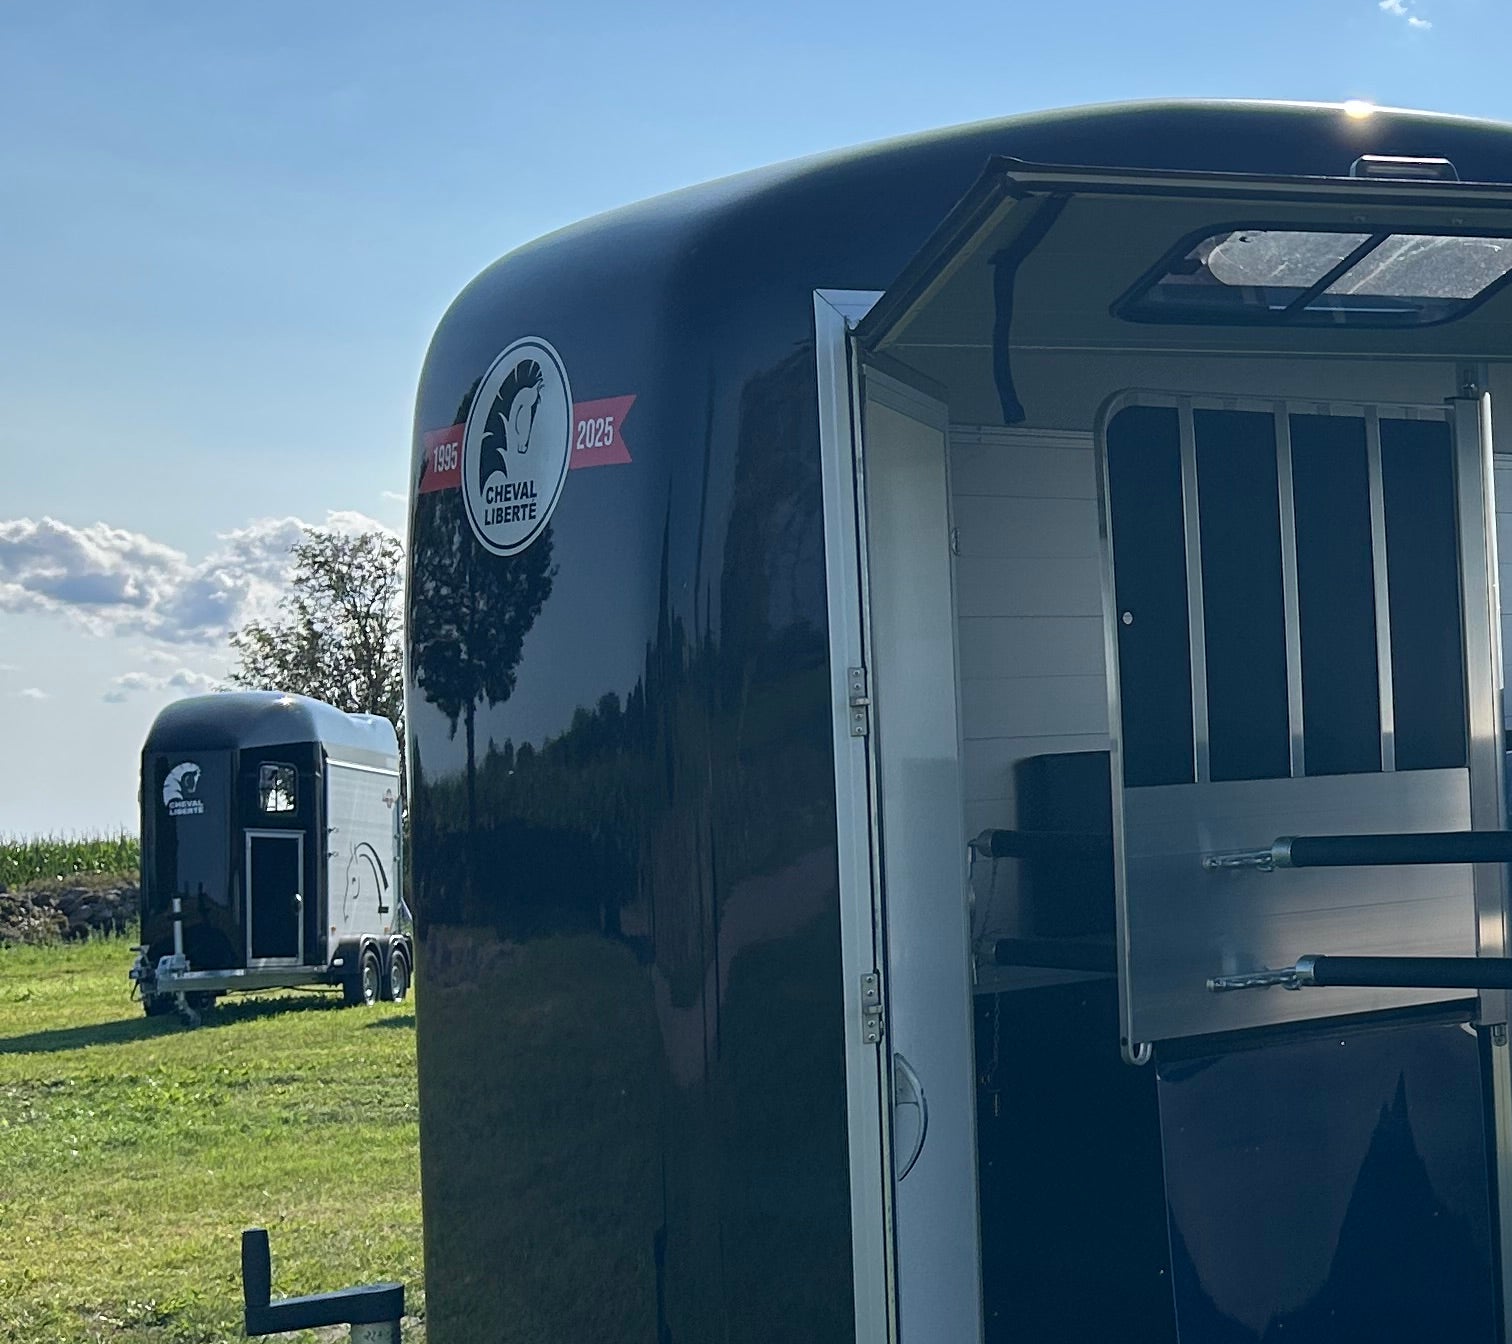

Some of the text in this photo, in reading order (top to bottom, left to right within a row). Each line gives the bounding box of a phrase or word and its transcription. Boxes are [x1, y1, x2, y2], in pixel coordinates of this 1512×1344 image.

[576, 416, 615, 450] 2025
[433, 442, 459, 473] 1995
[485, 479, 538, 505] CHEVAL
[484, 499, 538, 526] LIBERTÉ
